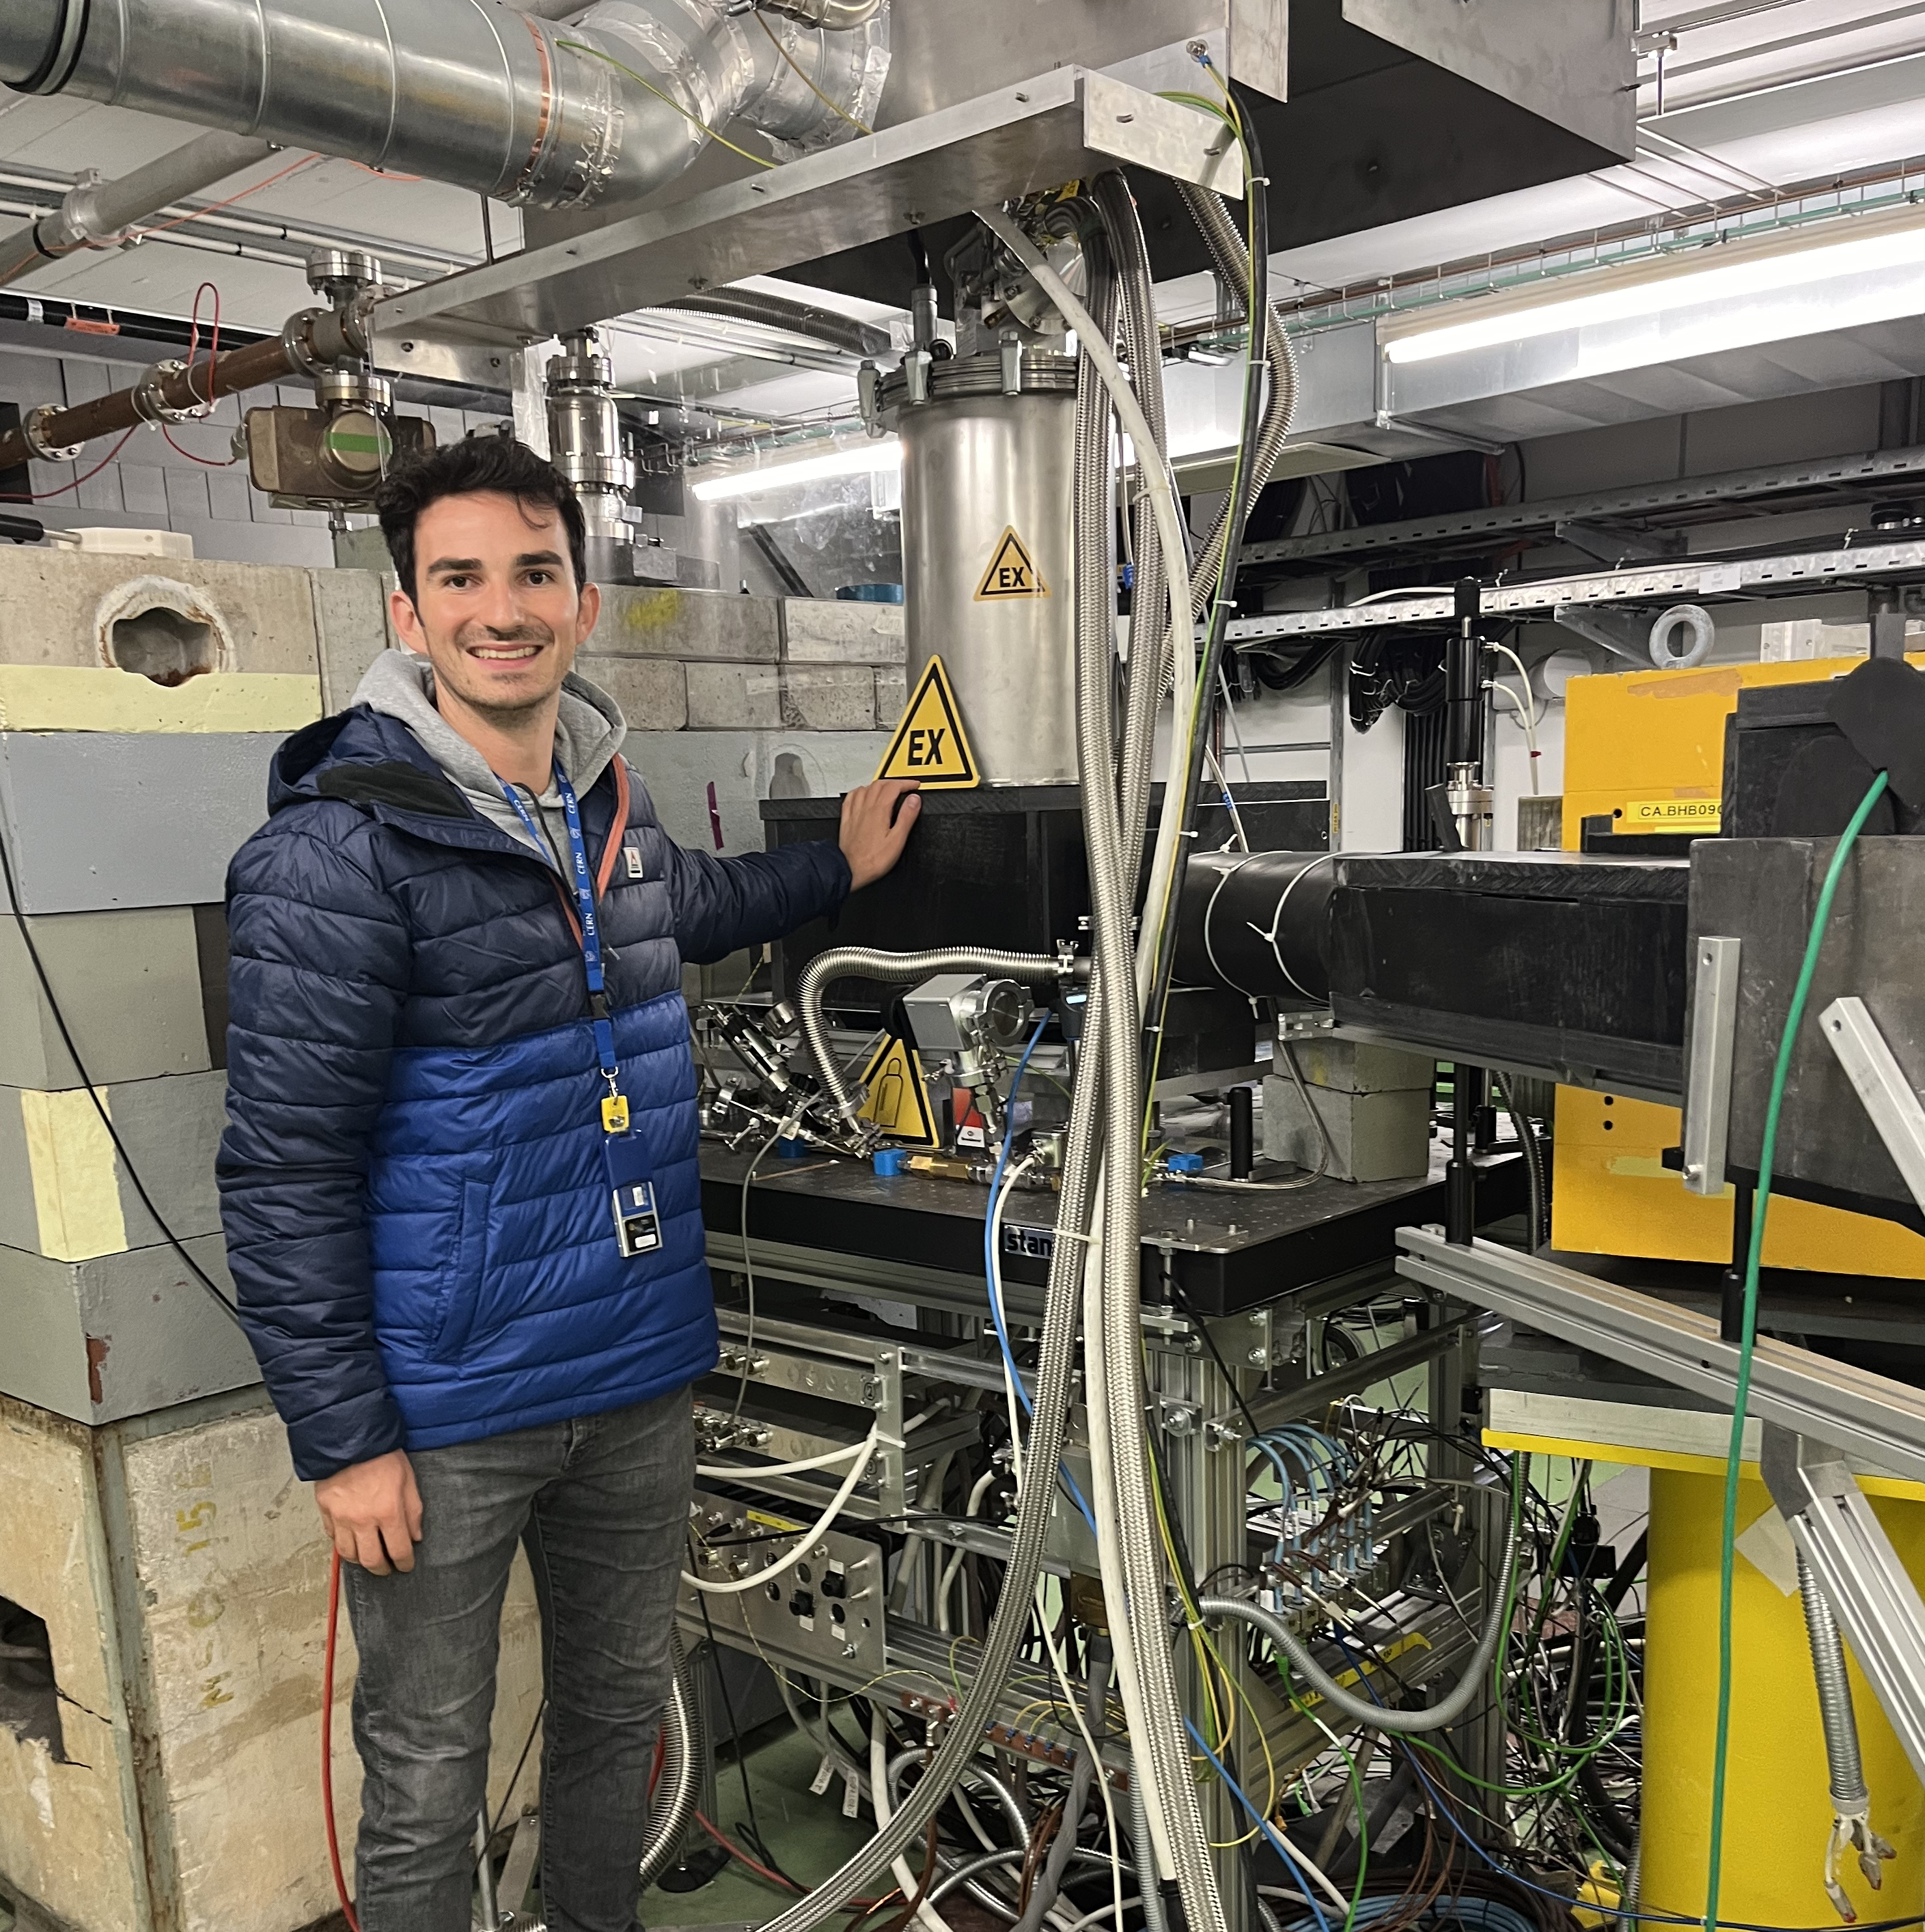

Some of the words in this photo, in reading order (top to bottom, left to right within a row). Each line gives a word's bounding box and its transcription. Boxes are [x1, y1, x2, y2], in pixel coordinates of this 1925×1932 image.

[999, 566, 1025, 588] EX
[907, 728, 945, 766] EX
[565, 792, 575, 814] CERN
[575, 852, 586, 874] CERN
[585, 913, 595, 936] CERN
